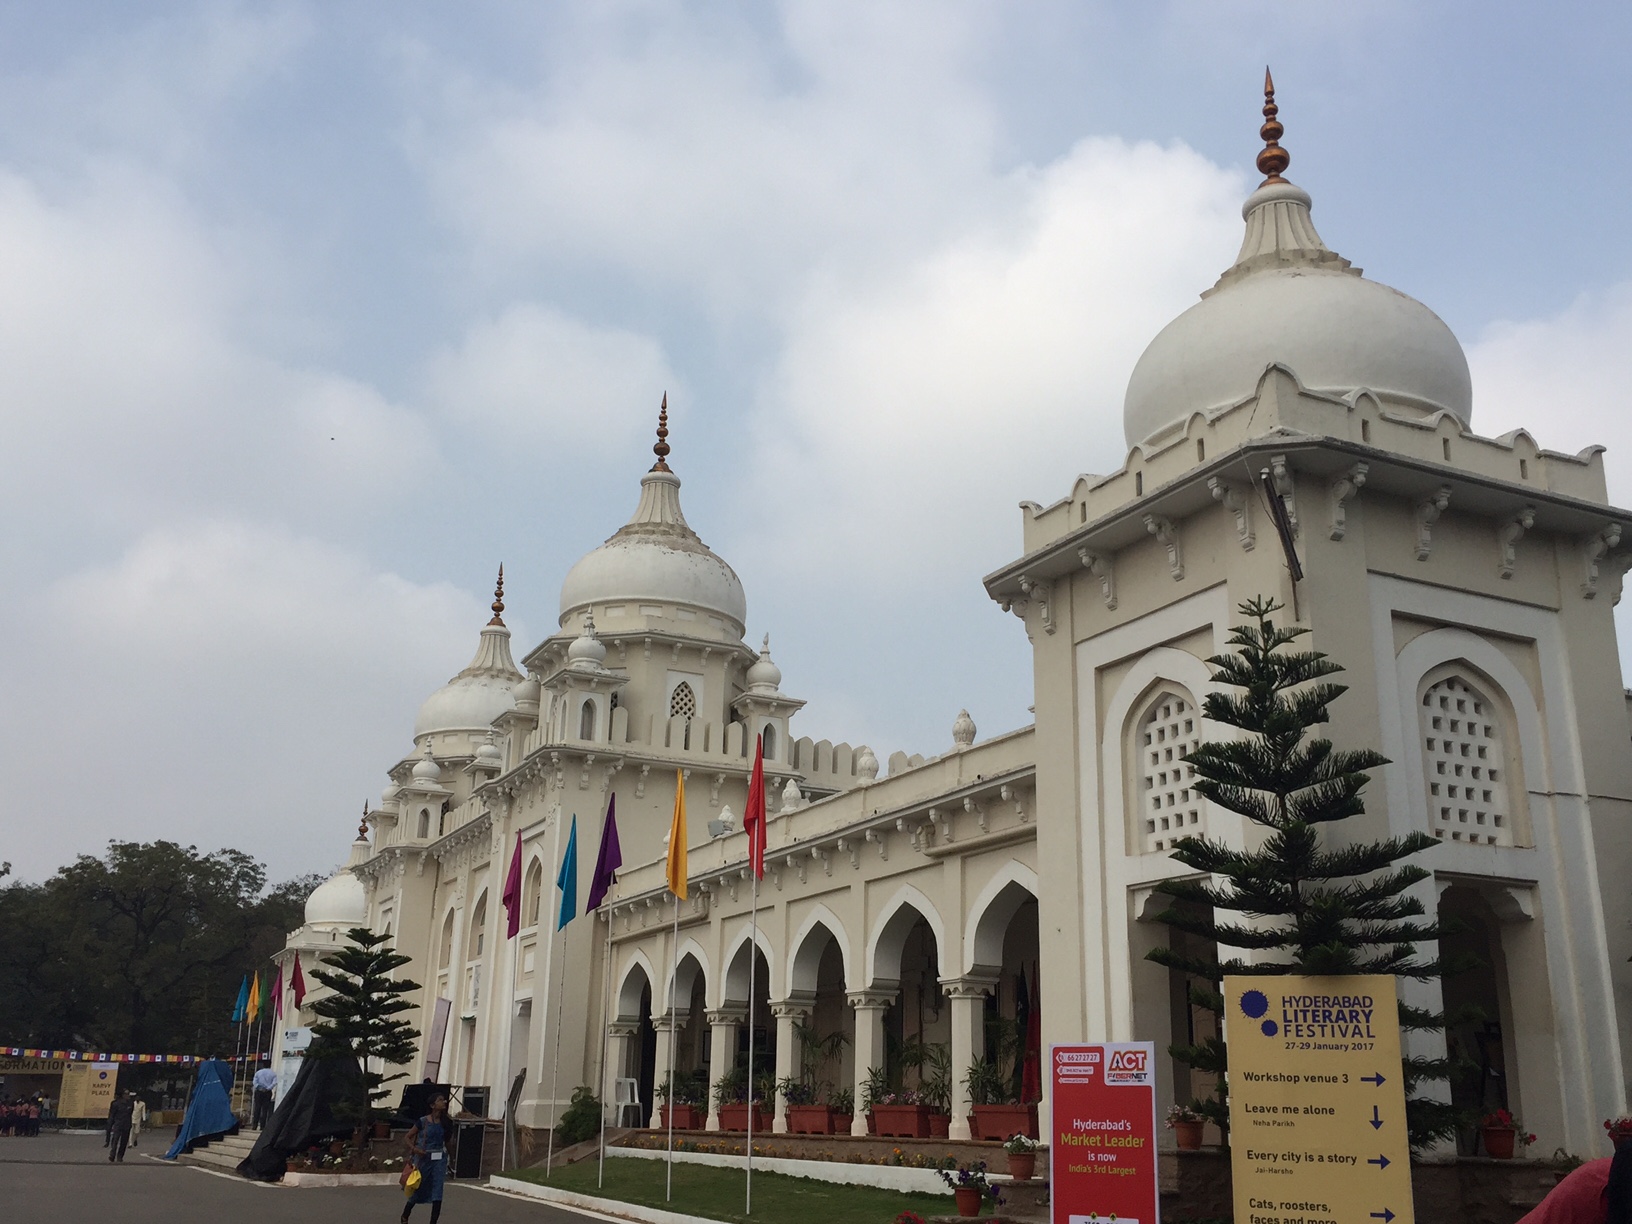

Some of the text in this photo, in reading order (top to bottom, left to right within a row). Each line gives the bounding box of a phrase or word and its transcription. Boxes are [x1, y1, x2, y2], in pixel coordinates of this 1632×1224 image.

[1282, 996, 1374, 1009] HYDERABAD
[1282, 1009, 1374, 1024] LITERARY
[1283, 1024, 1376, 1038] FESTIVAL
[1285, 1042, 1374, 1052] 27-29 January 2017
[1109, 1051, 1147, 1070] ACT
[1243, 1071, 1349, 1084] Workshop venue 3
[1245, 1103, 1335, 1115] Leave me alone
[1073, 1118, 1132, 1132] Hyderabad's
[1252, 1119, 1271, 1127] Neha
[1061, 1132, 1145, 1148] Market Leader
[1087, 1150, 1117, 1162] is now
[1247, 1149, 1357, 1165] Every city is a story
[1068, 1164, 1136, 1176] India's 3rd Largest
[1249, 1198, 1332, 1213] Cats, roosters,
[1250, 1213, 1280, 1224] faces
[1283, 1216, 1303, 1224] and
